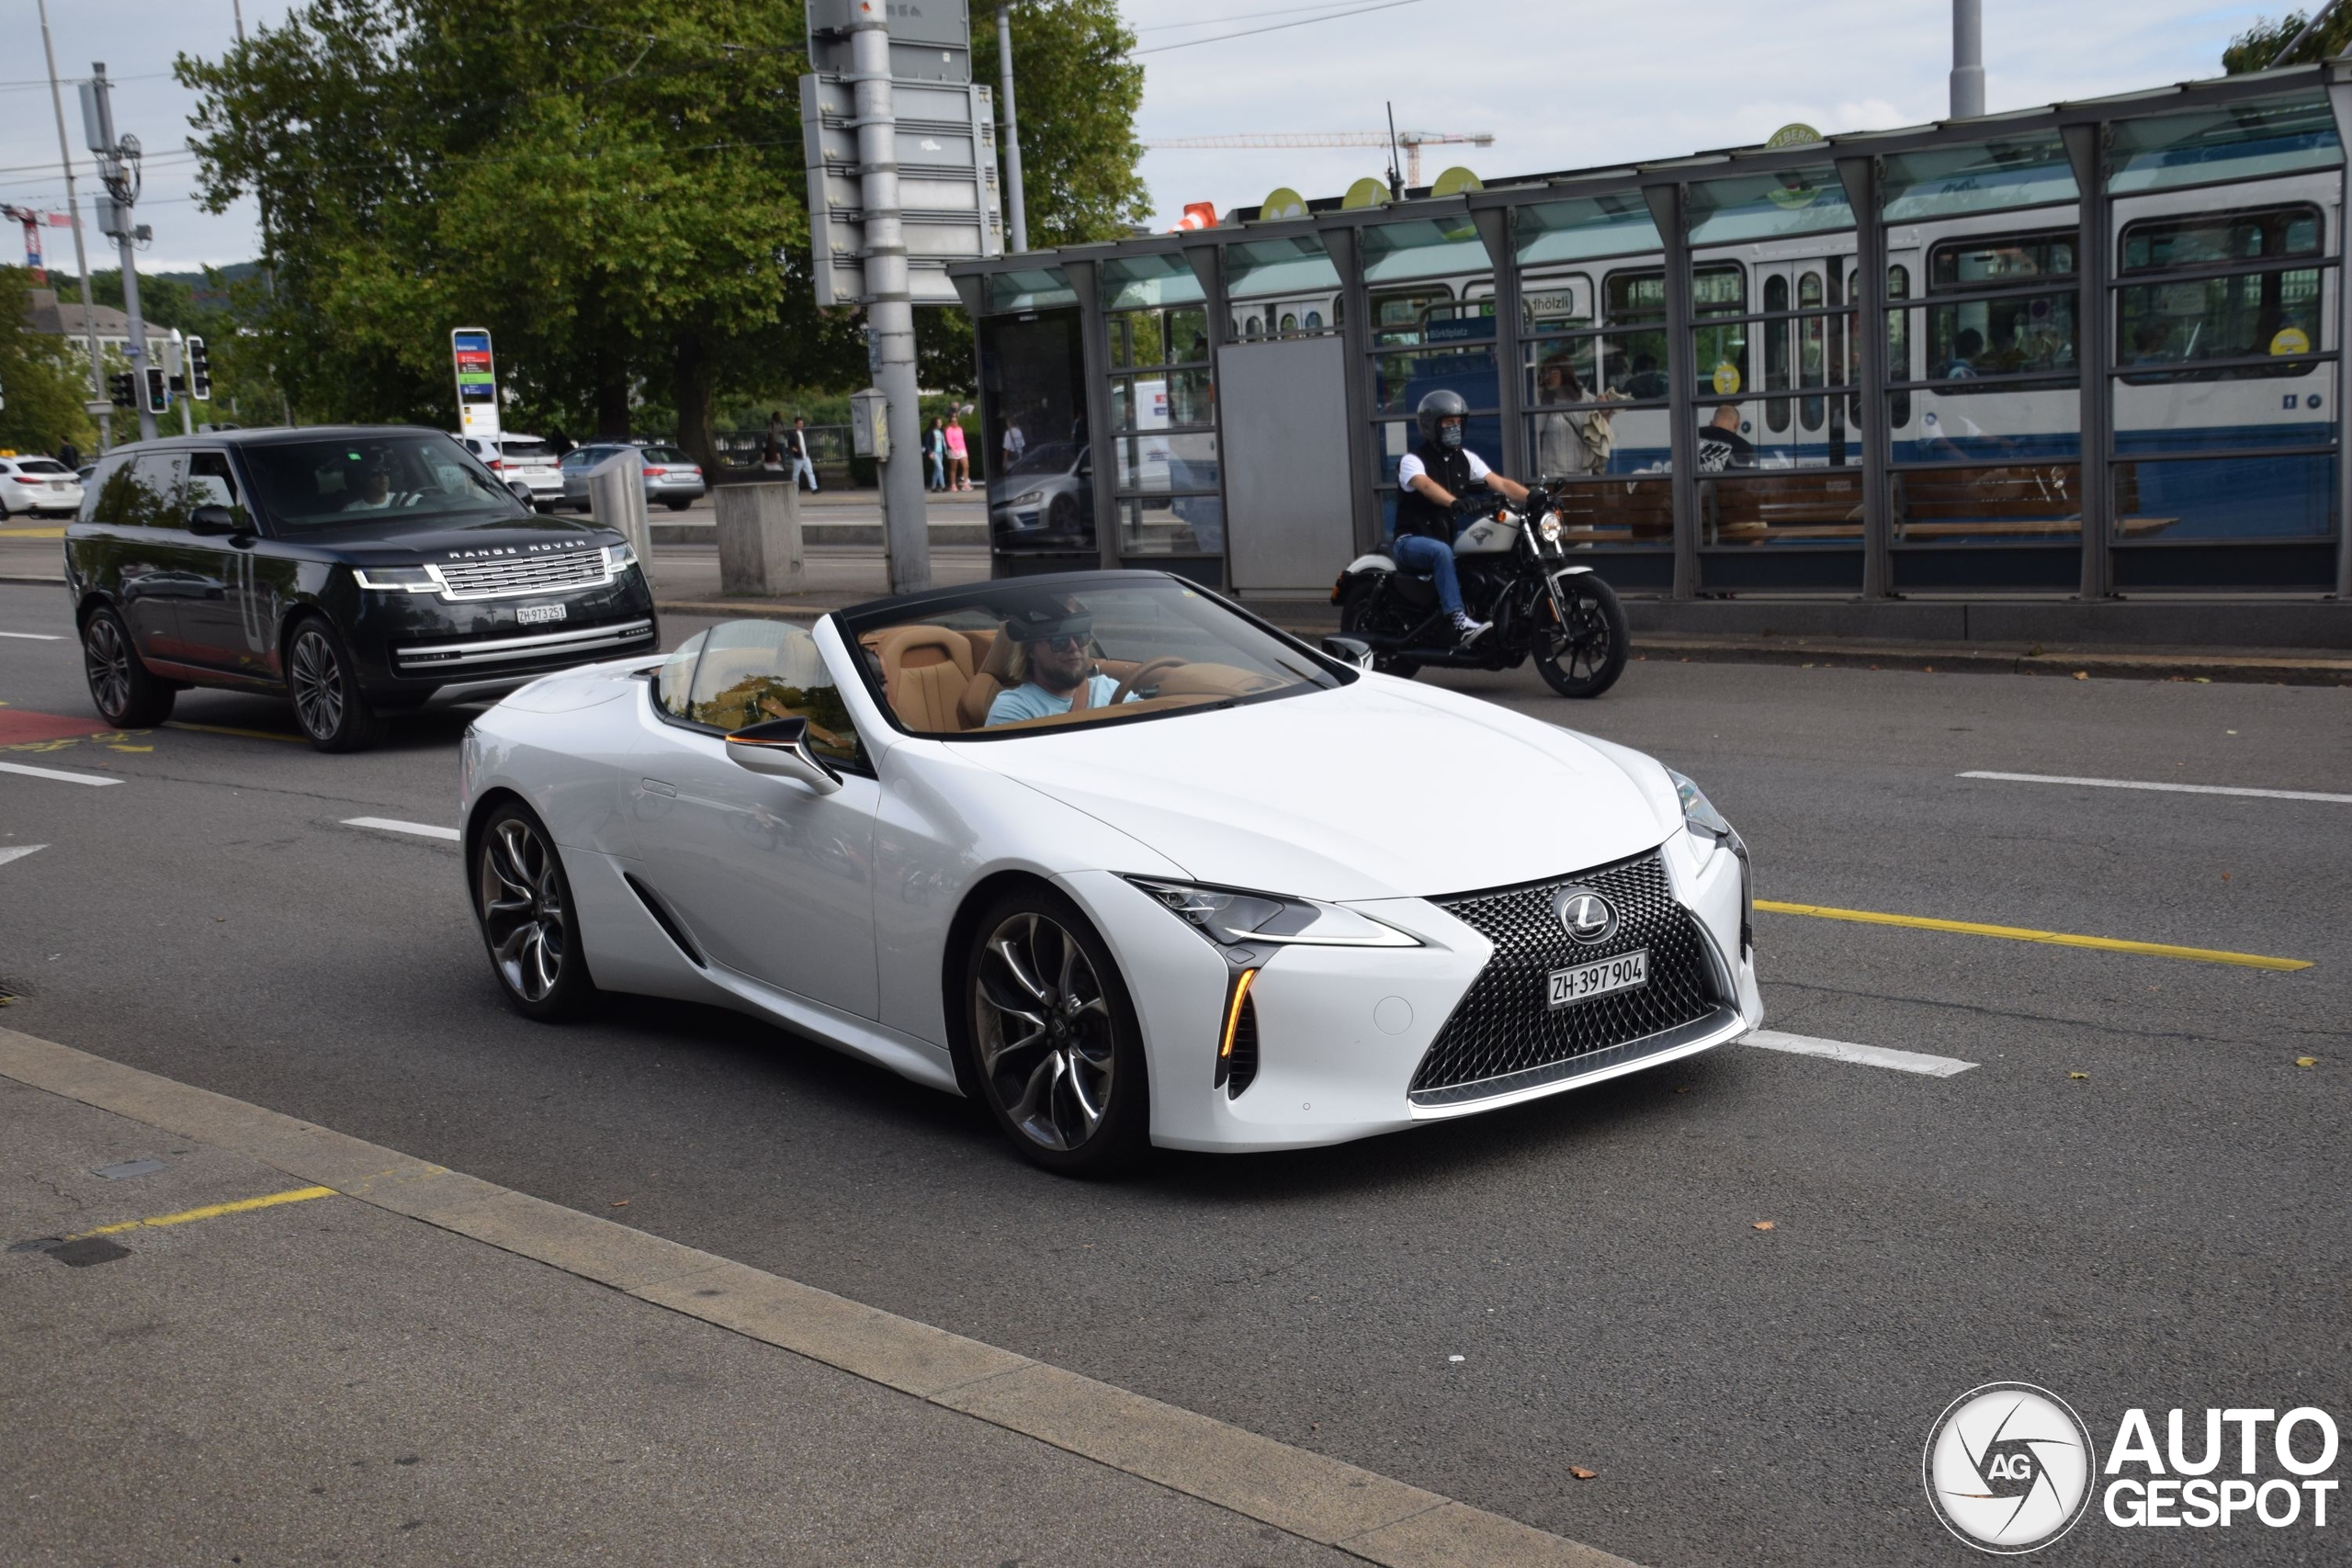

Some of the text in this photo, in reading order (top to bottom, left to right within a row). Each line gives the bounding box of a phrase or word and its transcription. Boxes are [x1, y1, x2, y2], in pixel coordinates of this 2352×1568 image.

[1430, 328, 1468, 339] Bürkliplatz
[449, 540, 586, 558] RANGE ROVER
